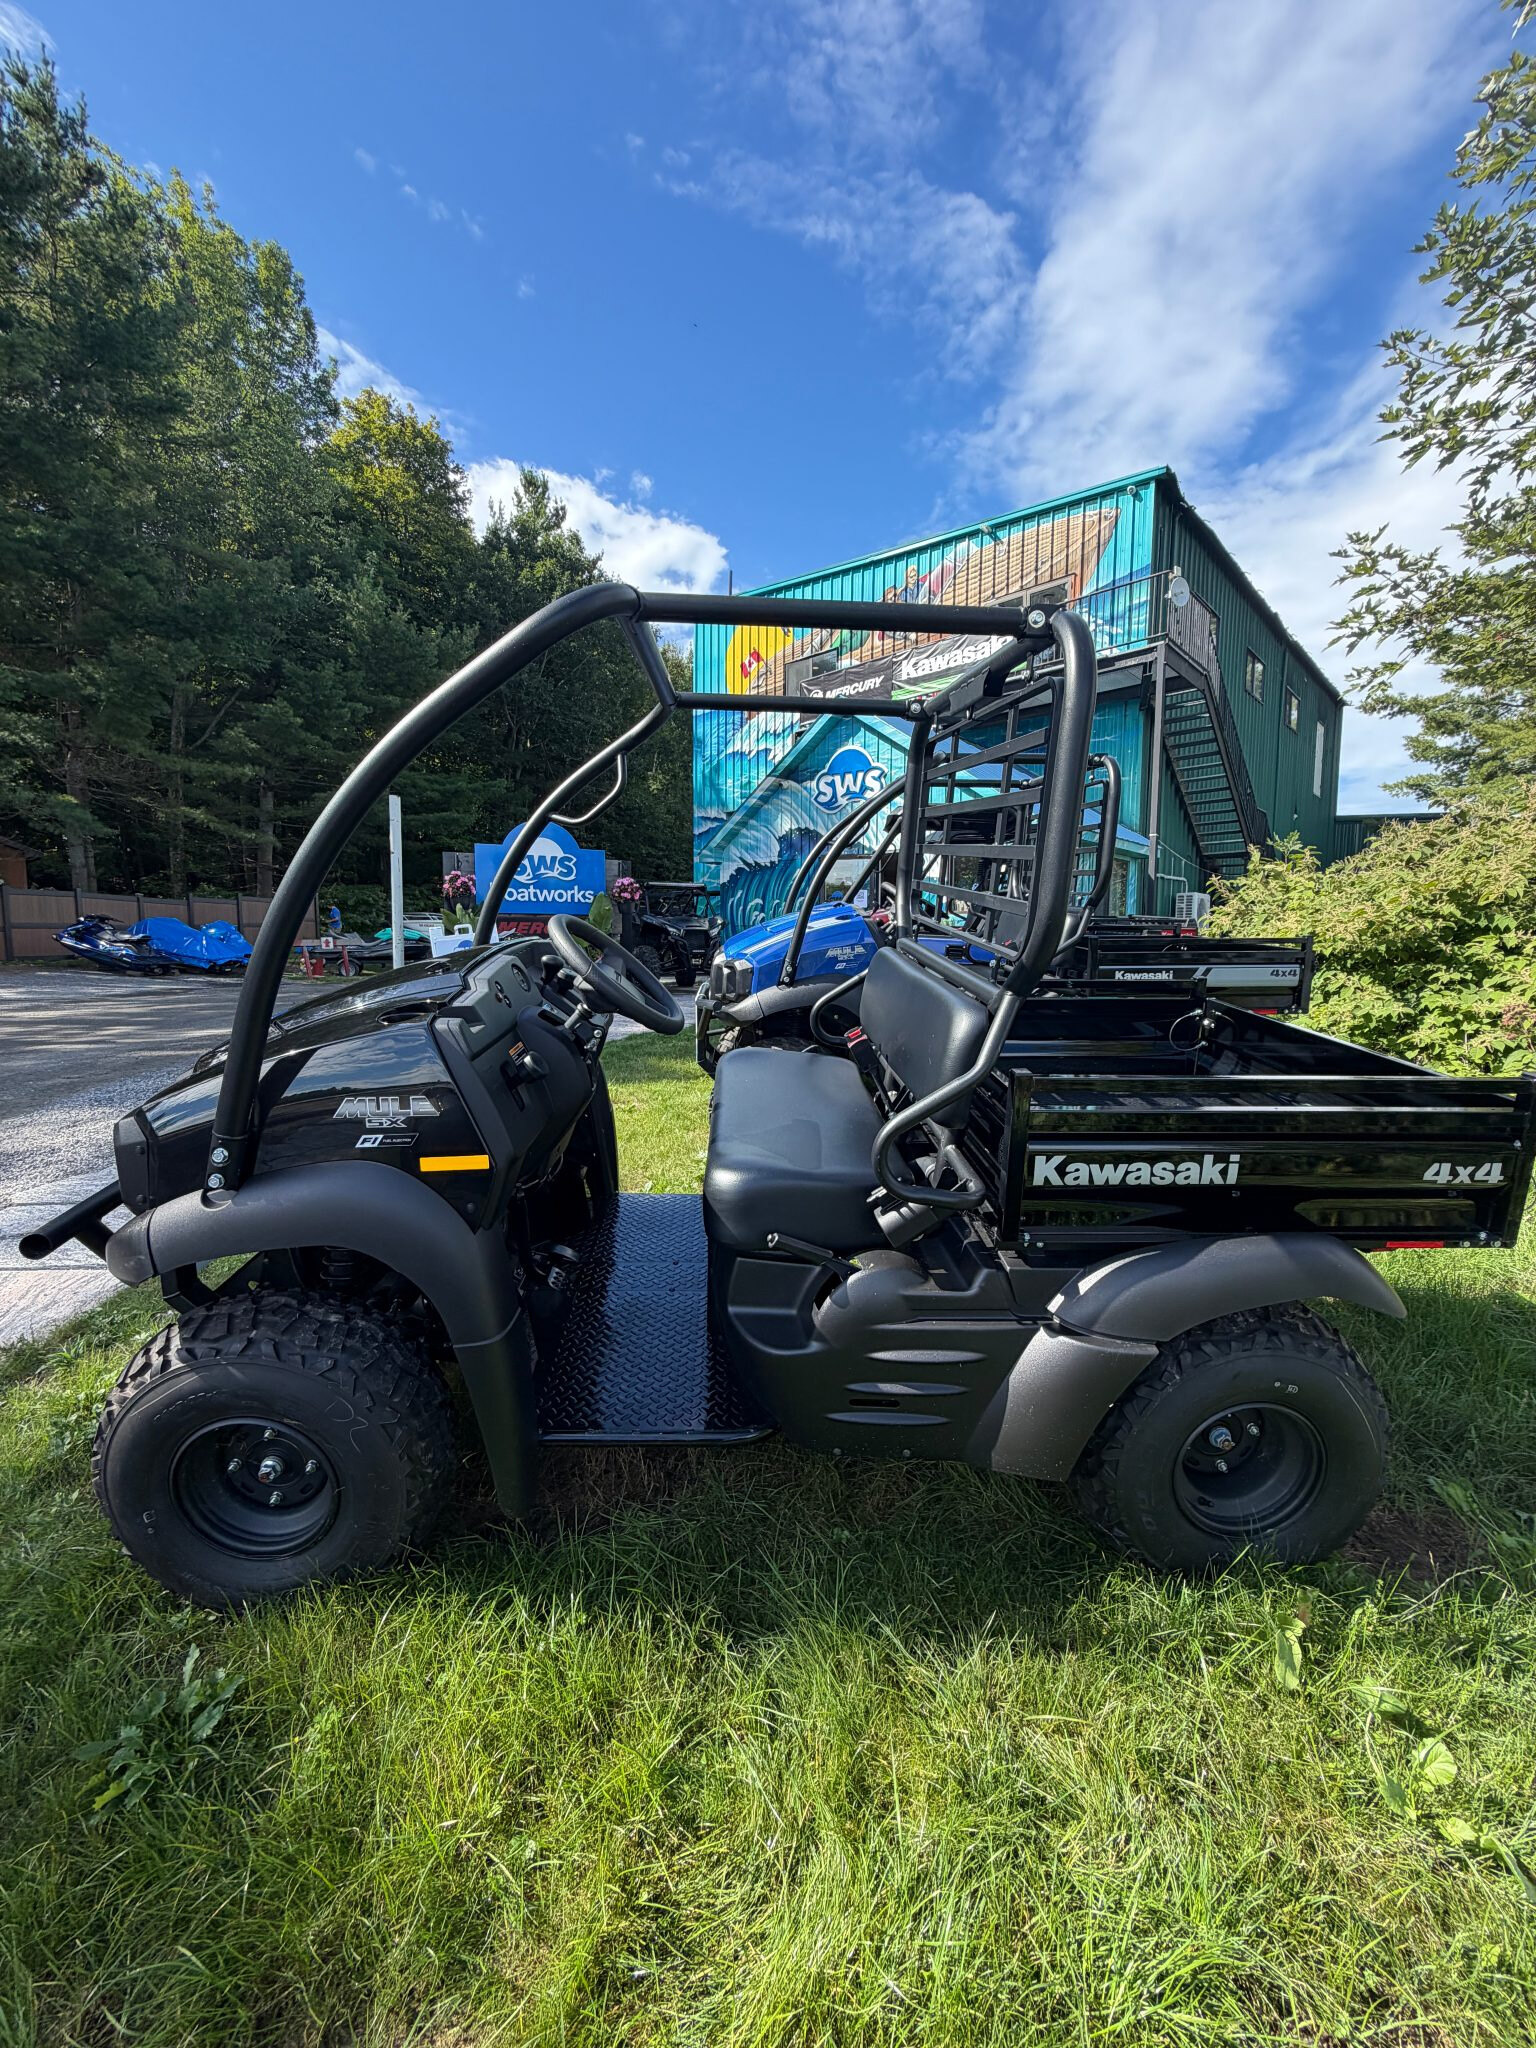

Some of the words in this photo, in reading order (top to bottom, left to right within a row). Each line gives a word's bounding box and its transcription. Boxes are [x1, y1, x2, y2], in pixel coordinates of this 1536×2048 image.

[902, 635, 1014, 679] Kawasak
[816, 768, 886, 803] SWS
[490, 883, 594, 903] oatworks
[1115, 970, 1174, 980] Kawasaki
[1270, 969, 1299, 978] 4x4
[333, 1095, 440, 1118] MULE
[366, 1117, 407, 1128] SX
[360, 1136, 379, 1145] FI
[1032, 1154, 1241, 1186] Kawasaki
[1422, 1162, 1505, 1184] 4x4
